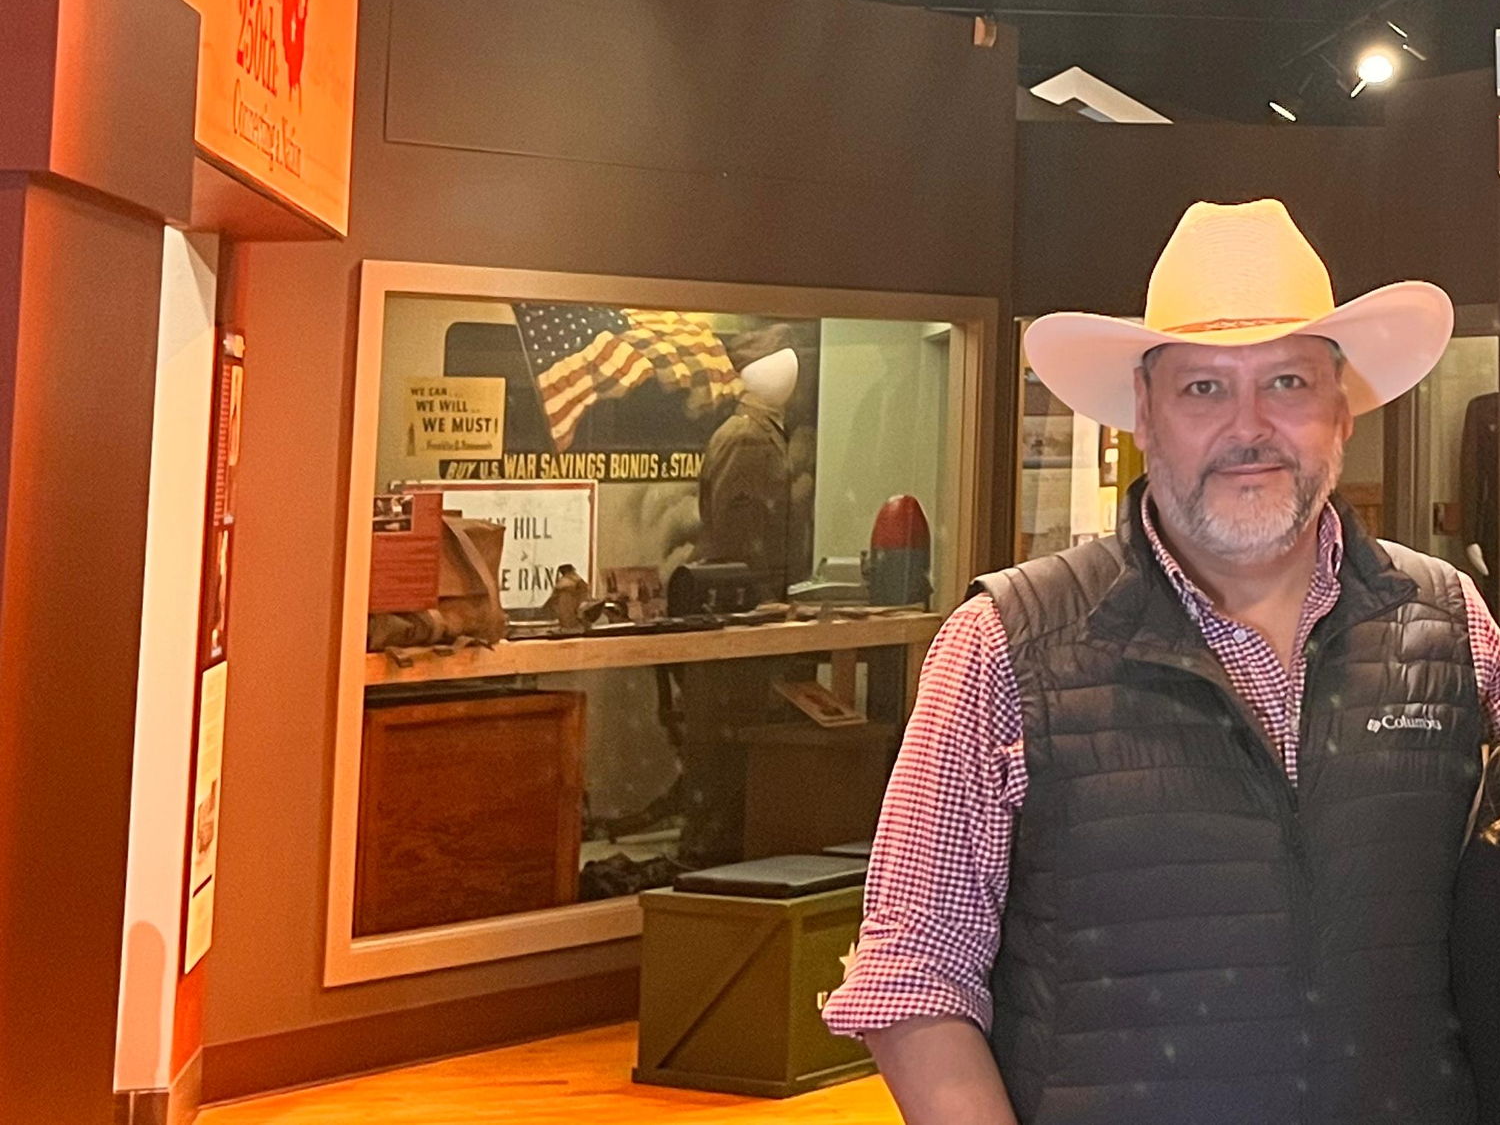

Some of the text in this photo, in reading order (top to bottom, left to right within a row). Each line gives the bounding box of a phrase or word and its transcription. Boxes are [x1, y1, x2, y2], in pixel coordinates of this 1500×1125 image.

[410, 387, 425, 396] WE
[416, 400, 435, 413] WE
[422, 417, 499, 435] WE MUST!
[448, 461, 477, 479] BUY
[504, 453, 536, 479] WAR
[540, 453, 606, 479] SAVINGS
[610, 453, 659, 479] BONDS
[662, 462, 669, 478] &
[513, 516, 553, 540] HILL
